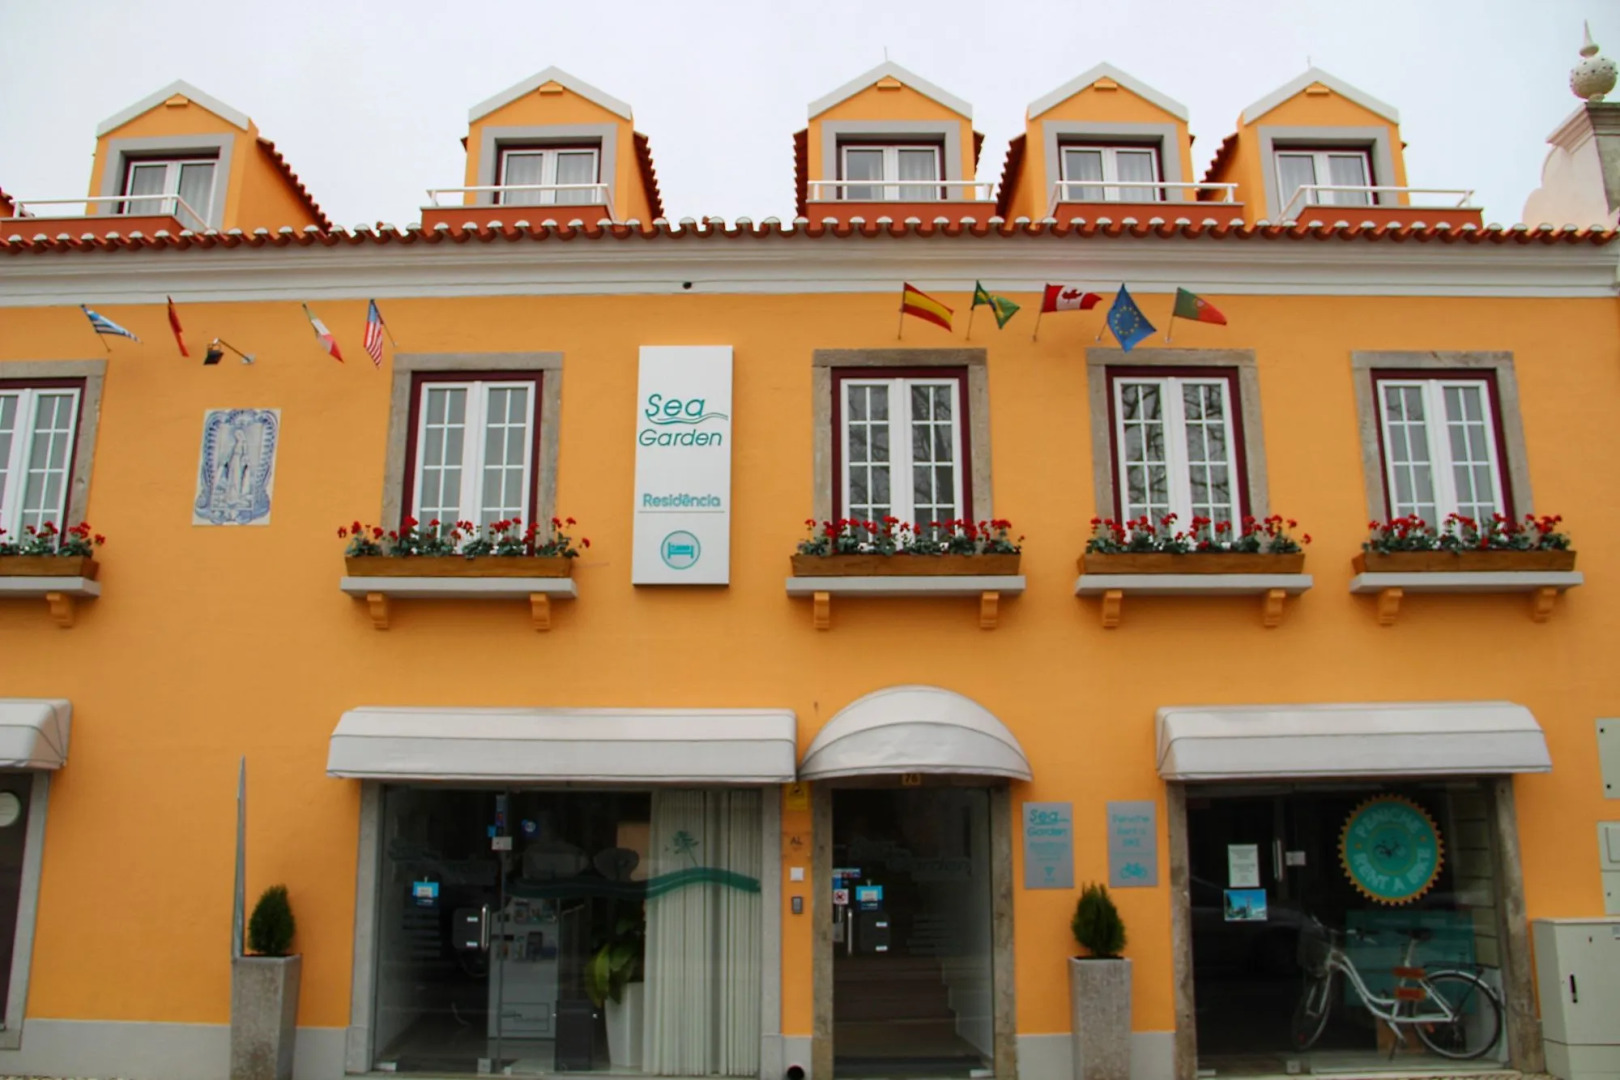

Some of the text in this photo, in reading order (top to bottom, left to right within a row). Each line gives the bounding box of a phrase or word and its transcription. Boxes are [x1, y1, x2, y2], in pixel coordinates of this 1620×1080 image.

[645, 393, 706, 418] Sea
[639, 429, 722, 447] Garden
[642, 493, 721, 508] Residência
[1030, 809, 1059, 823] Sea
[1353, 852, 1390, 890] RENT
[1391, 876, 1407, 893] A
